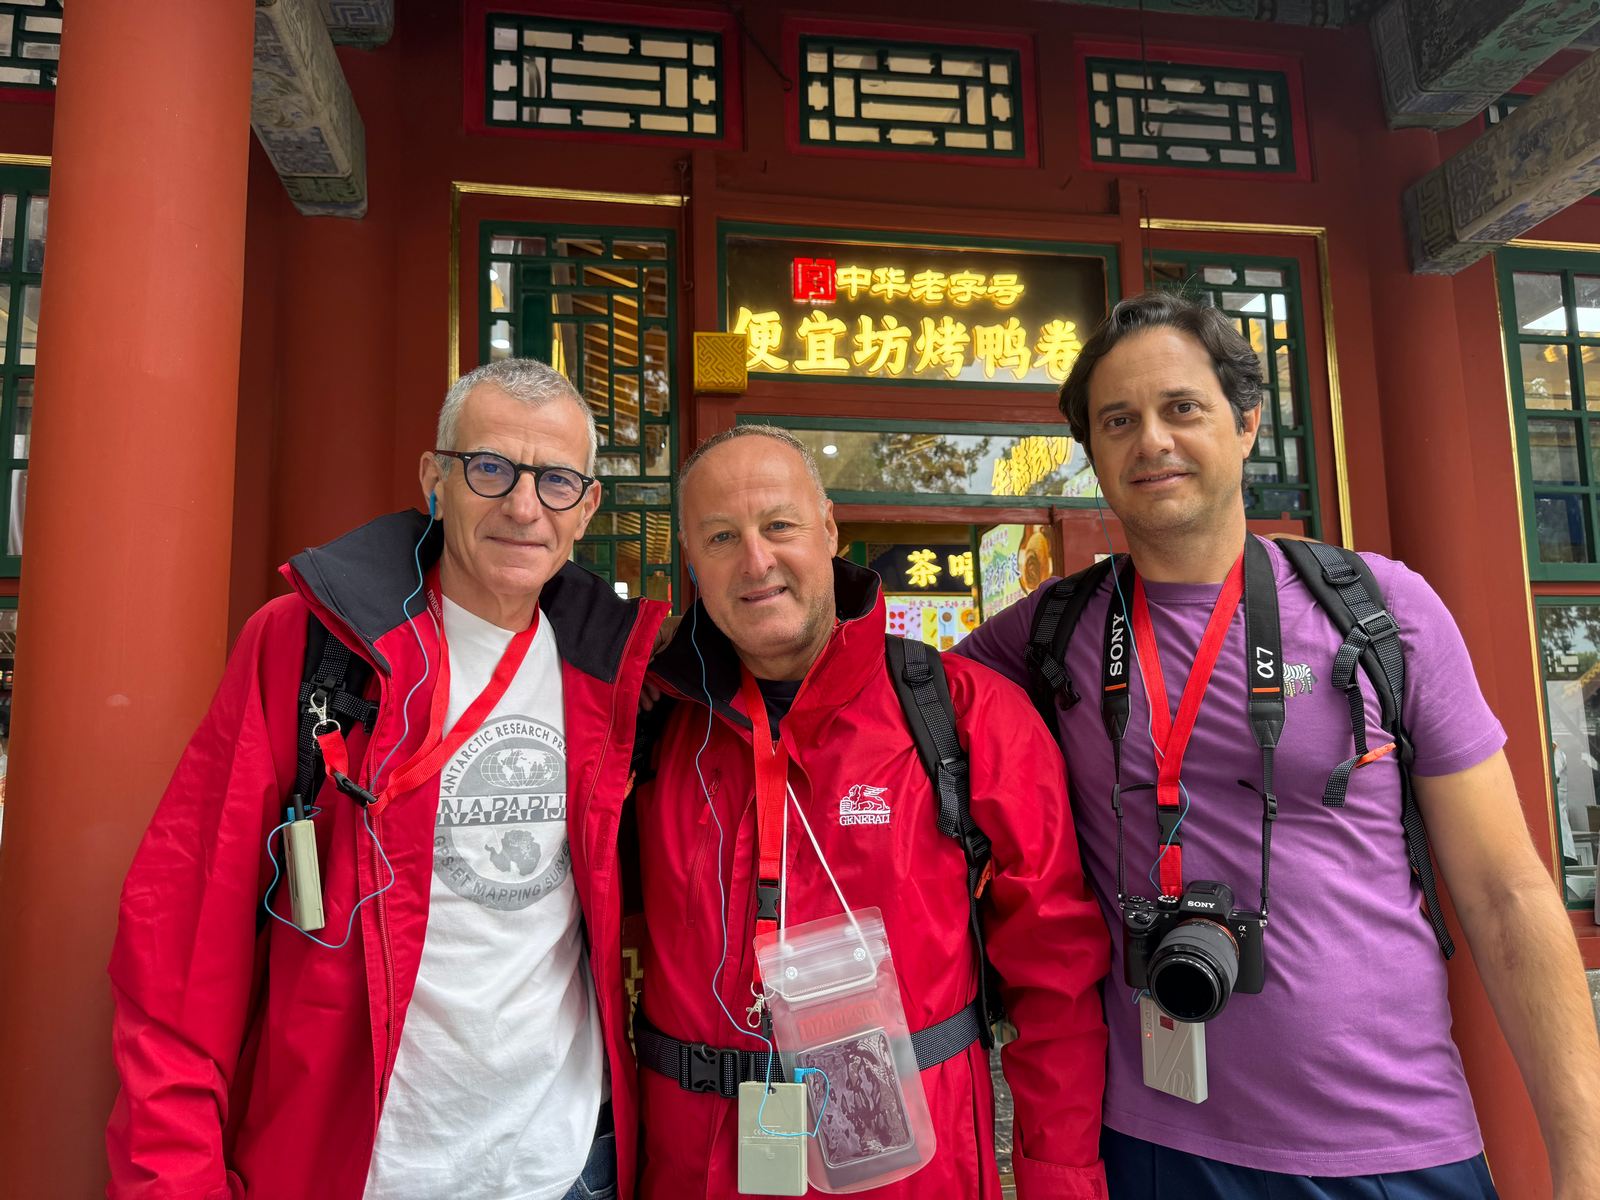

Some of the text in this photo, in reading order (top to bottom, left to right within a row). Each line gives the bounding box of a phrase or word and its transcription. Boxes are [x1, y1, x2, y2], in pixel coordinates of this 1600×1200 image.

[836, 265, 1025, 308] 中华老字号
[733, 306, 1082, 380] 便宜坊烤鸭卷
[1110, 613, 1126, 677] SONY
[441, 730, 493, 794] ANTARCTIC
[495, 723, 549, 742] RESEARCH
[438, 795, 566, 824] NAPAPIJ
[839, 814, 890, 826] GENERALI
[473, 882, 541, 901] MAPPING
[545, 841, 570, 890] SURVE
[1187, 901, 1215, 909] SONY
